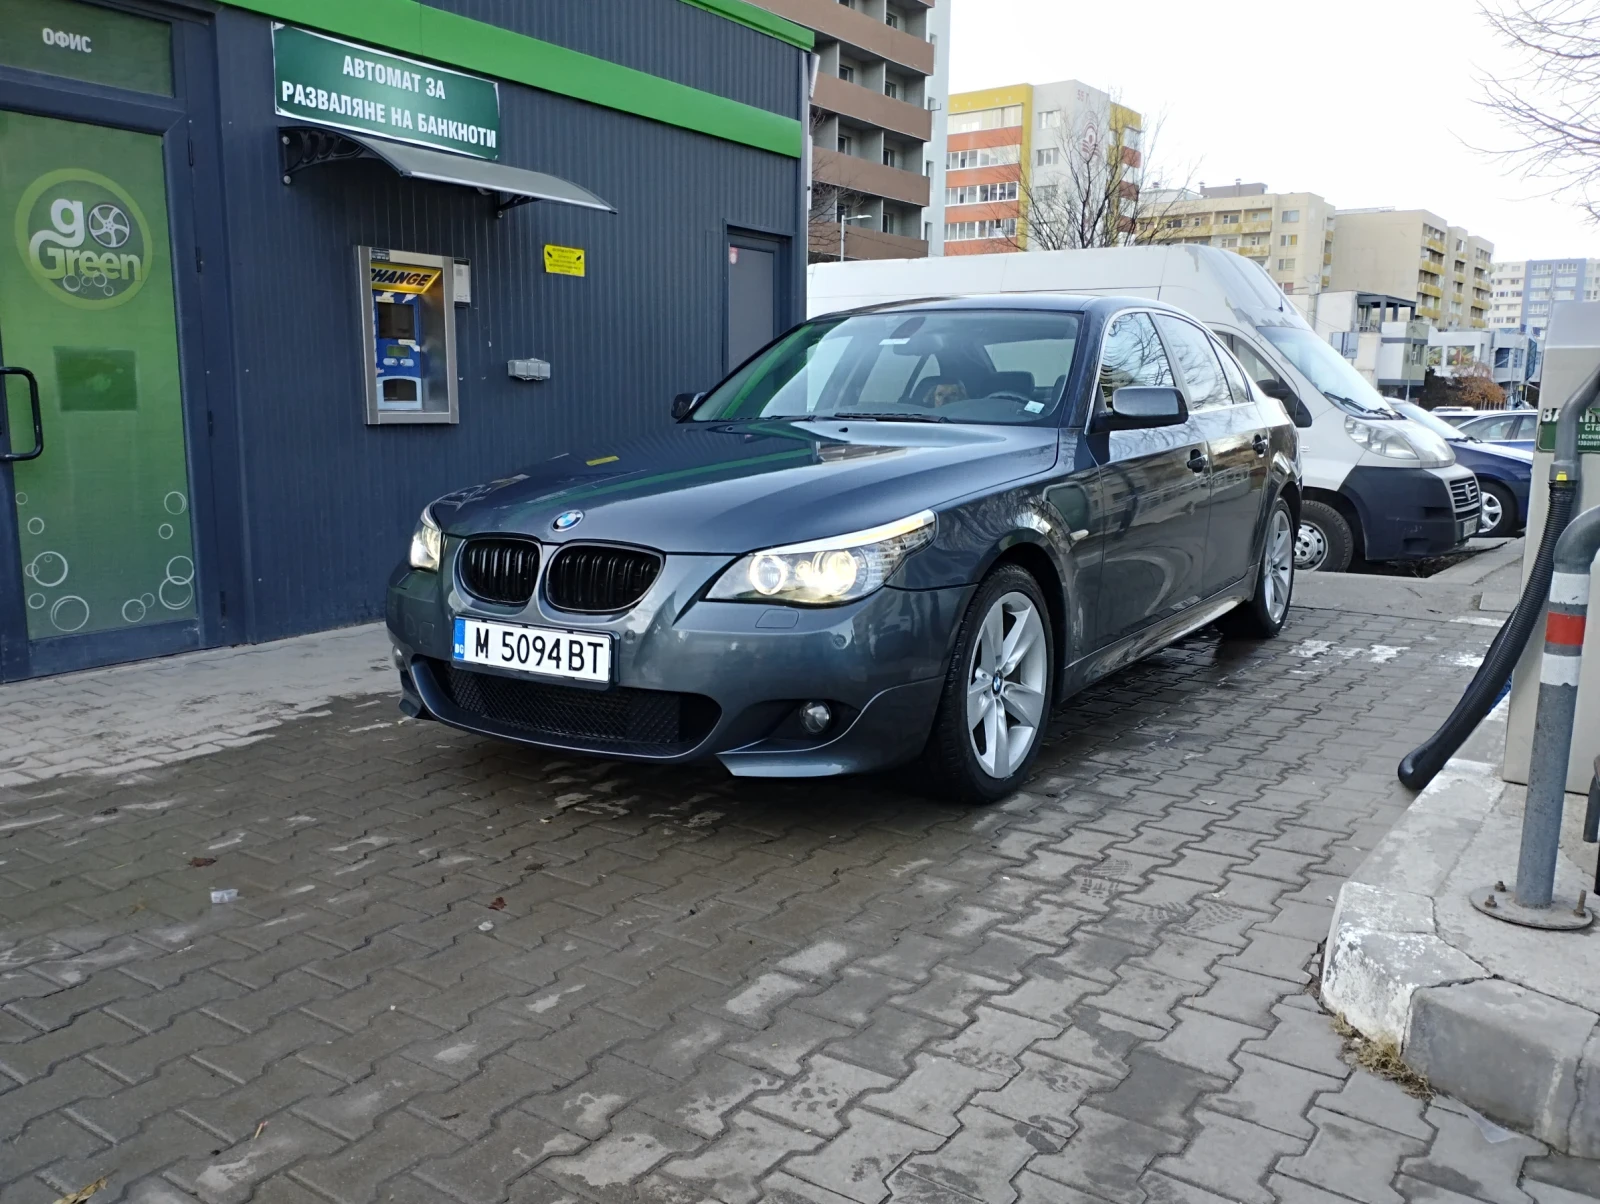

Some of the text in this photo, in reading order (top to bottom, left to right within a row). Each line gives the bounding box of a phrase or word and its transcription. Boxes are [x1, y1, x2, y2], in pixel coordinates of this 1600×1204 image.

[42, 27, 92, 53] ОФИС
[342, 55, 446, 100] АВТОМАТ ЗА
[281, 80, 497, 149] РАЗВАЛЯНЕ НА БАНКНОТИ
[29, 230, 142, 281] Green
